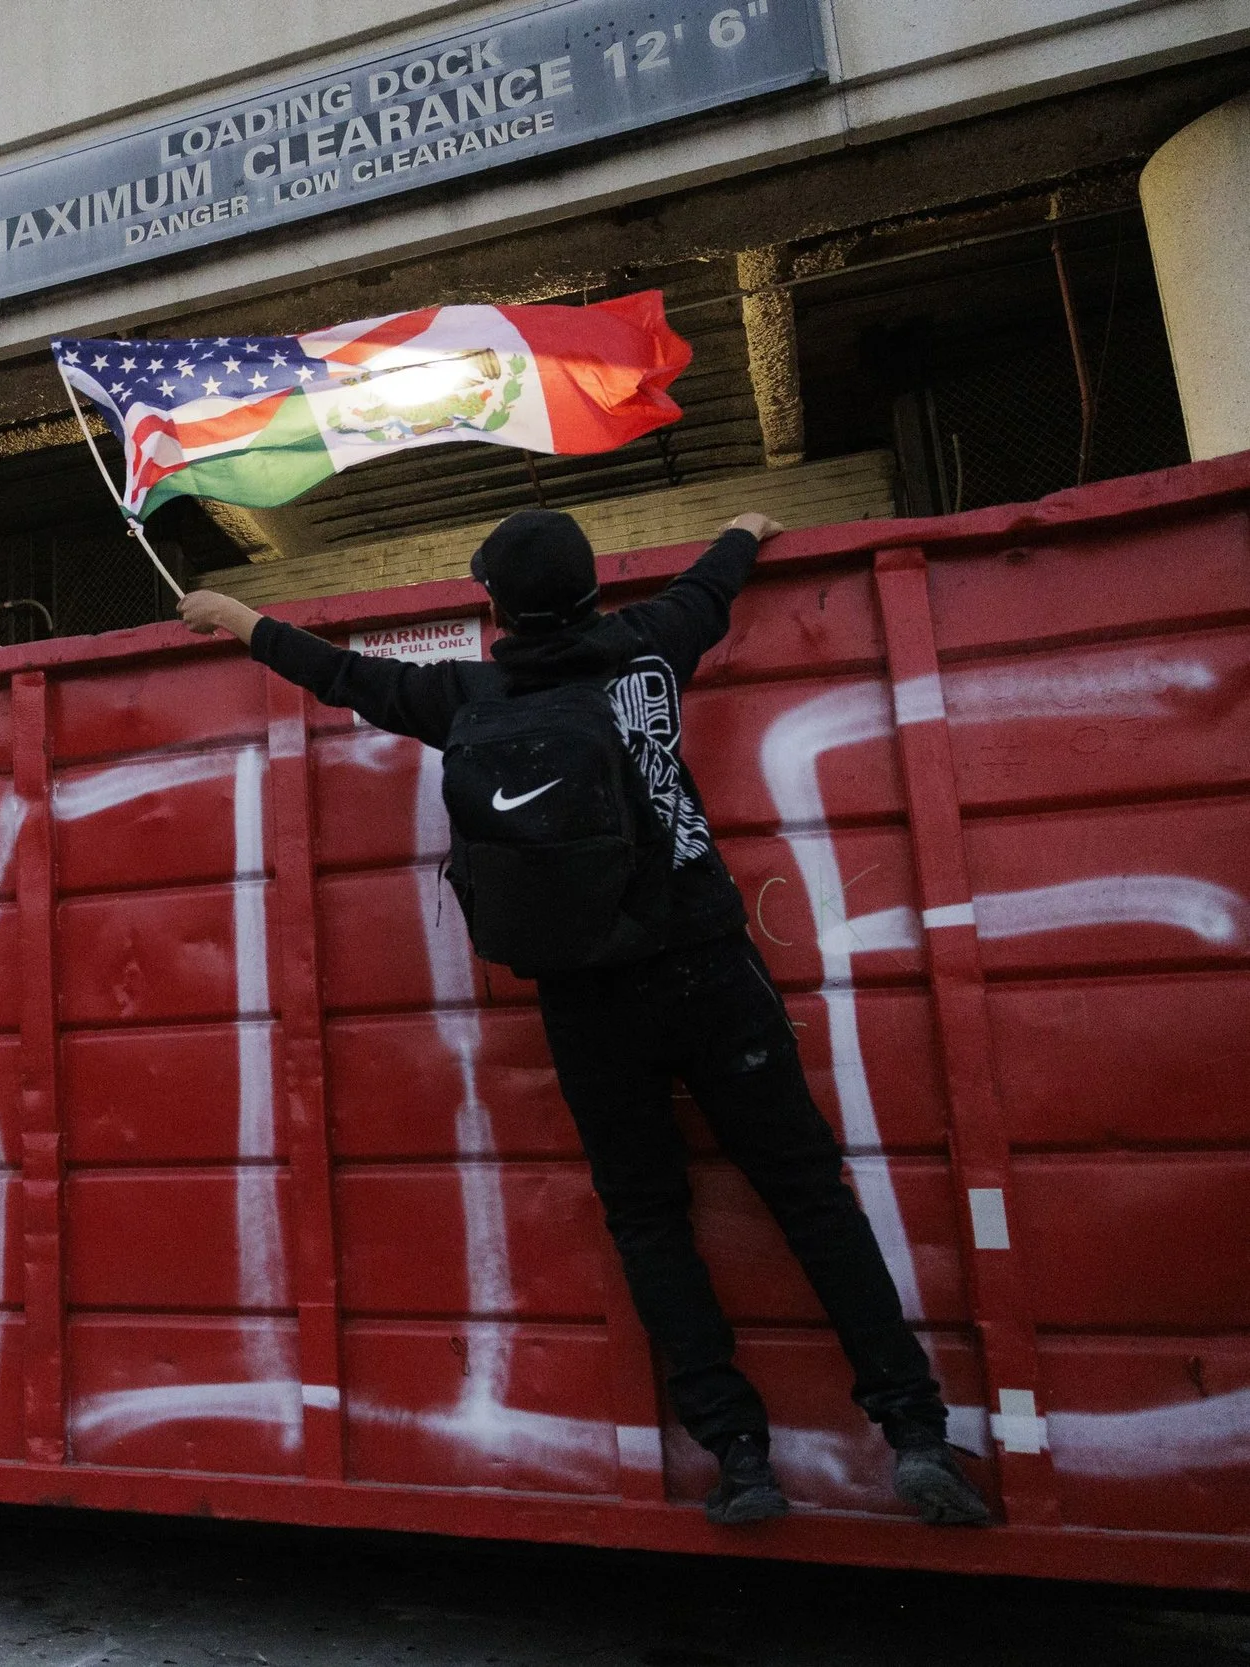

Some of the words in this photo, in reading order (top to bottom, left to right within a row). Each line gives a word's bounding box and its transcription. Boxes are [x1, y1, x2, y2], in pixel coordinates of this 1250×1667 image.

[160, 83, 353, 164] LOADING
[368, 36, 504, 103] DOCK
[243, 55, 574, 182] CLEARANCE
[603, 23, 683, 80] 12'
[125, 195, 250, 246] DANGER
[273, 168, 341, 206] LOW
[352, 110, 555, 183] CLEARANCE
[363, 623, 466, 648] WARNING
[363, 647, 397, 658] EVEL
[401, 642, 434, 655] FULL
[438, 637, 474, 650] ONLY
